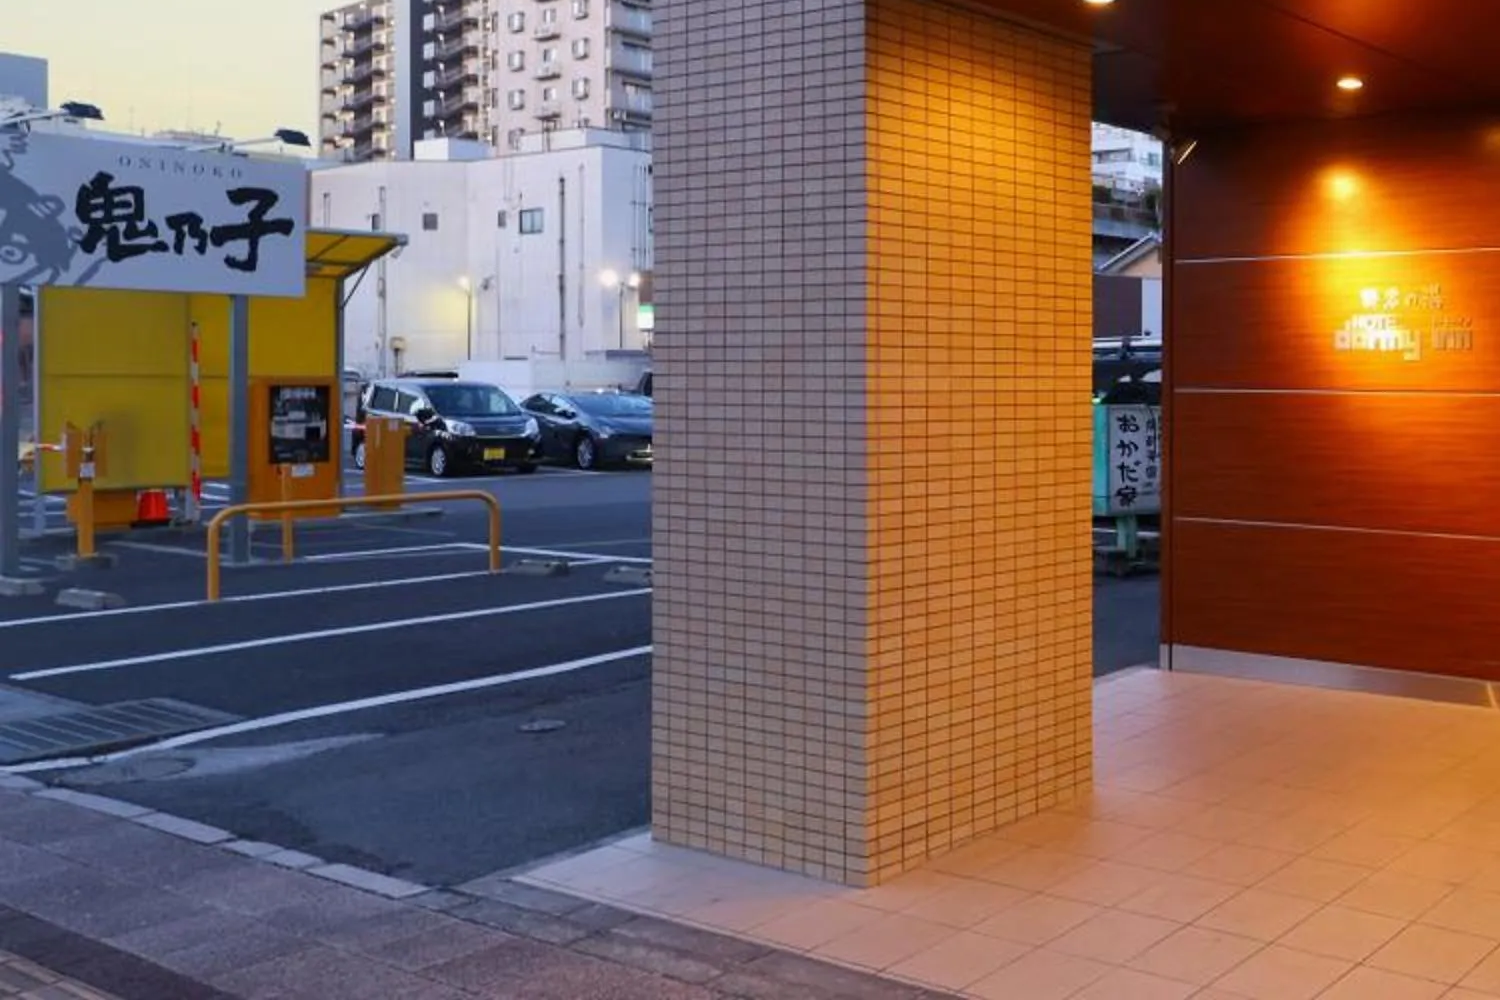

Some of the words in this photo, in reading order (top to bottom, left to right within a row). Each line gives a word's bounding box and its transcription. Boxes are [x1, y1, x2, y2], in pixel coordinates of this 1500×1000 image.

[118, 154, 243, 179] ONINOKO
[75, 171, 294, 272] 鬼乃子
[1334, 320, 1421, 361] dormy
[1115, 413, 1141, 507] おかだ家
